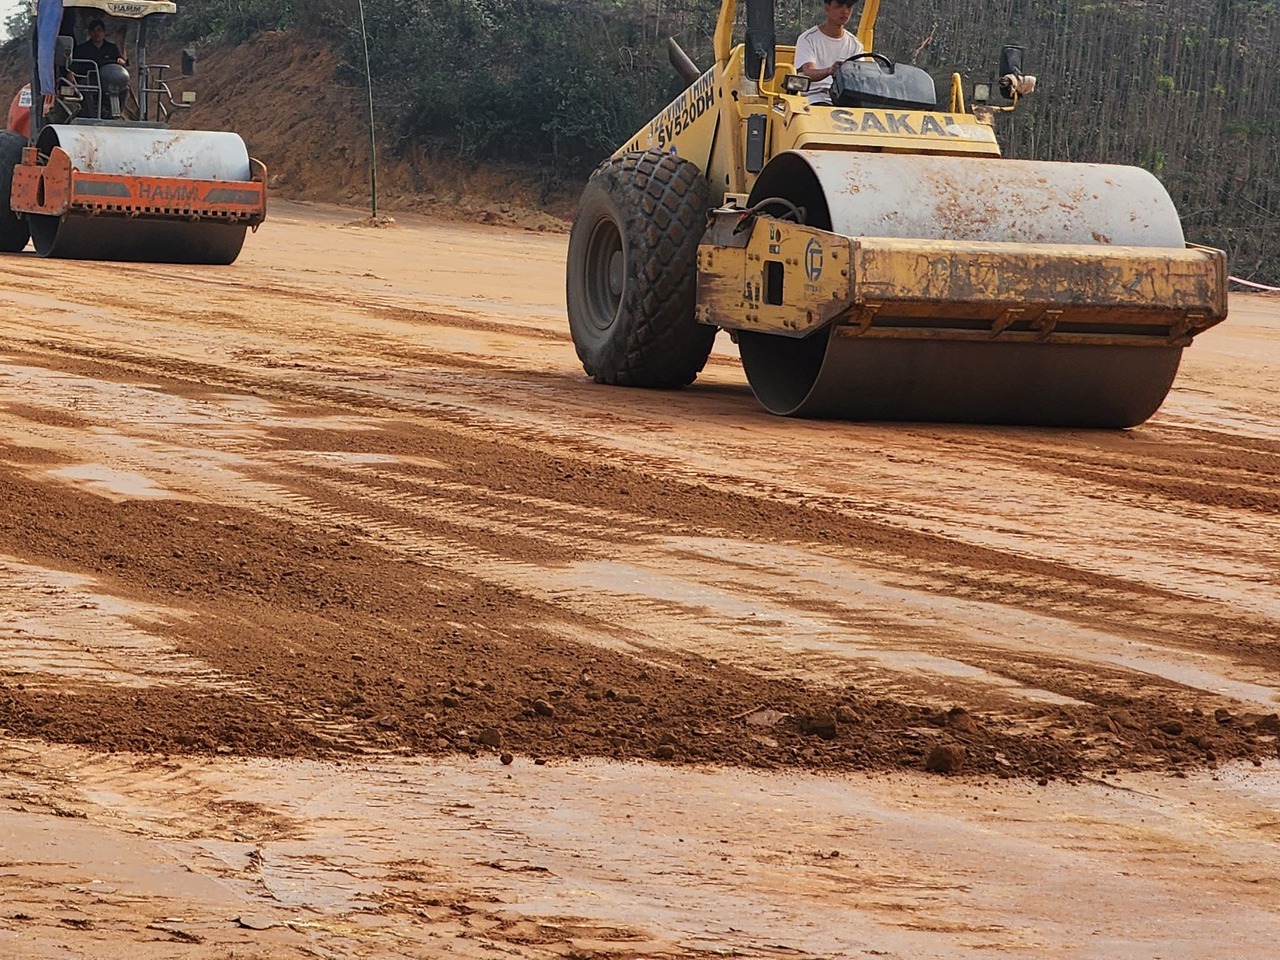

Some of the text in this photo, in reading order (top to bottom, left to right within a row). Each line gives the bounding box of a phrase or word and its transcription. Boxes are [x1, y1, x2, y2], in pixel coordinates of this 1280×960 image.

[113, 3, 142, 13] HAMM
[657, 86, 715, 149] SV520DH
[139, 182, 199, 202] HAMM
